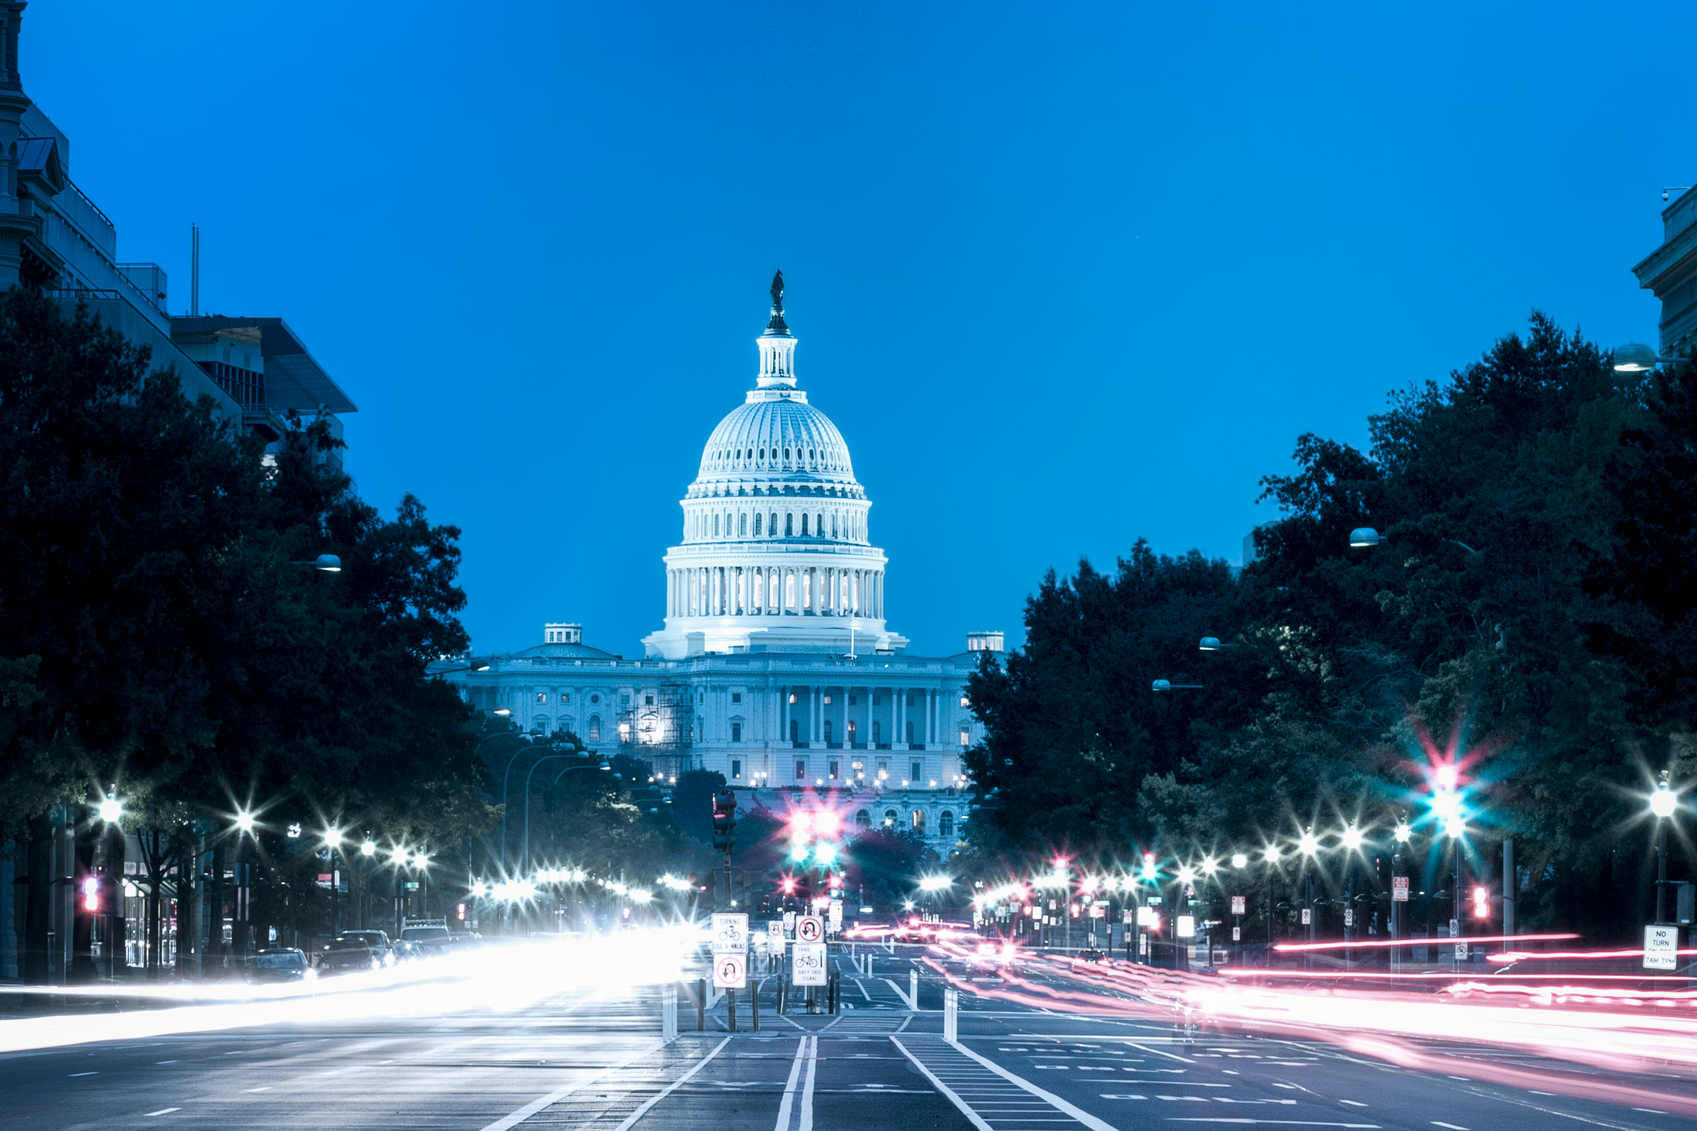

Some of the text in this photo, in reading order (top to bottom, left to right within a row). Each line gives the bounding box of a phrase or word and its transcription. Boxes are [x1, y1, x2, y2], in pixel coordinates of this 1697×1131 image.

[713, 942, 723, 950] USE
[1034, 1065, 1187, 1074] ONLY
[1098, 1094, 1297, 1105] ONLY
